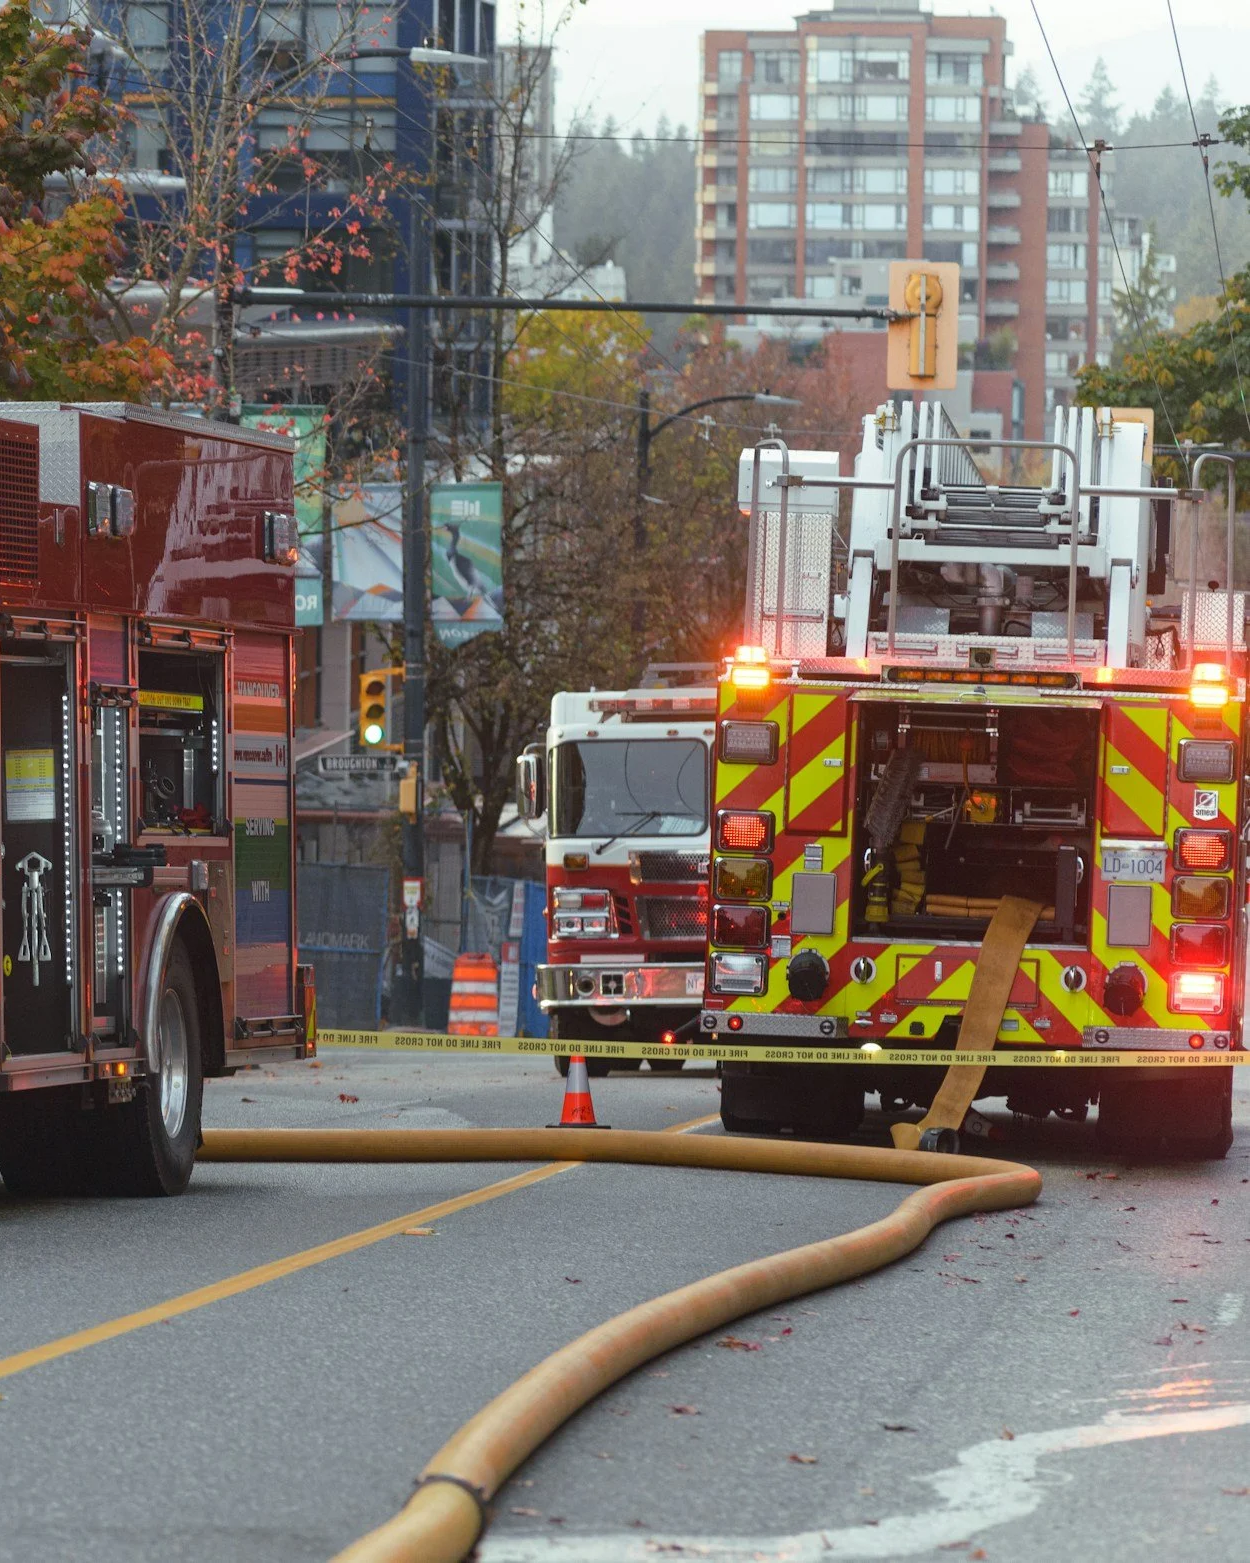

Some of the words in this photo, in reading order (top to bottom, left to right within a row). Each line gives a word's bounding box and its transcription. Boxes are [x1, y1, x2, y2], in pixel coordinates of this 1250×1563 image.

[326, 758, 378, 770] BROUGHTON
[1195, 808, 1216, 816] smeal
[246, 817, 274, 836] SERVING
[252, 880, 270, 902] WITH
